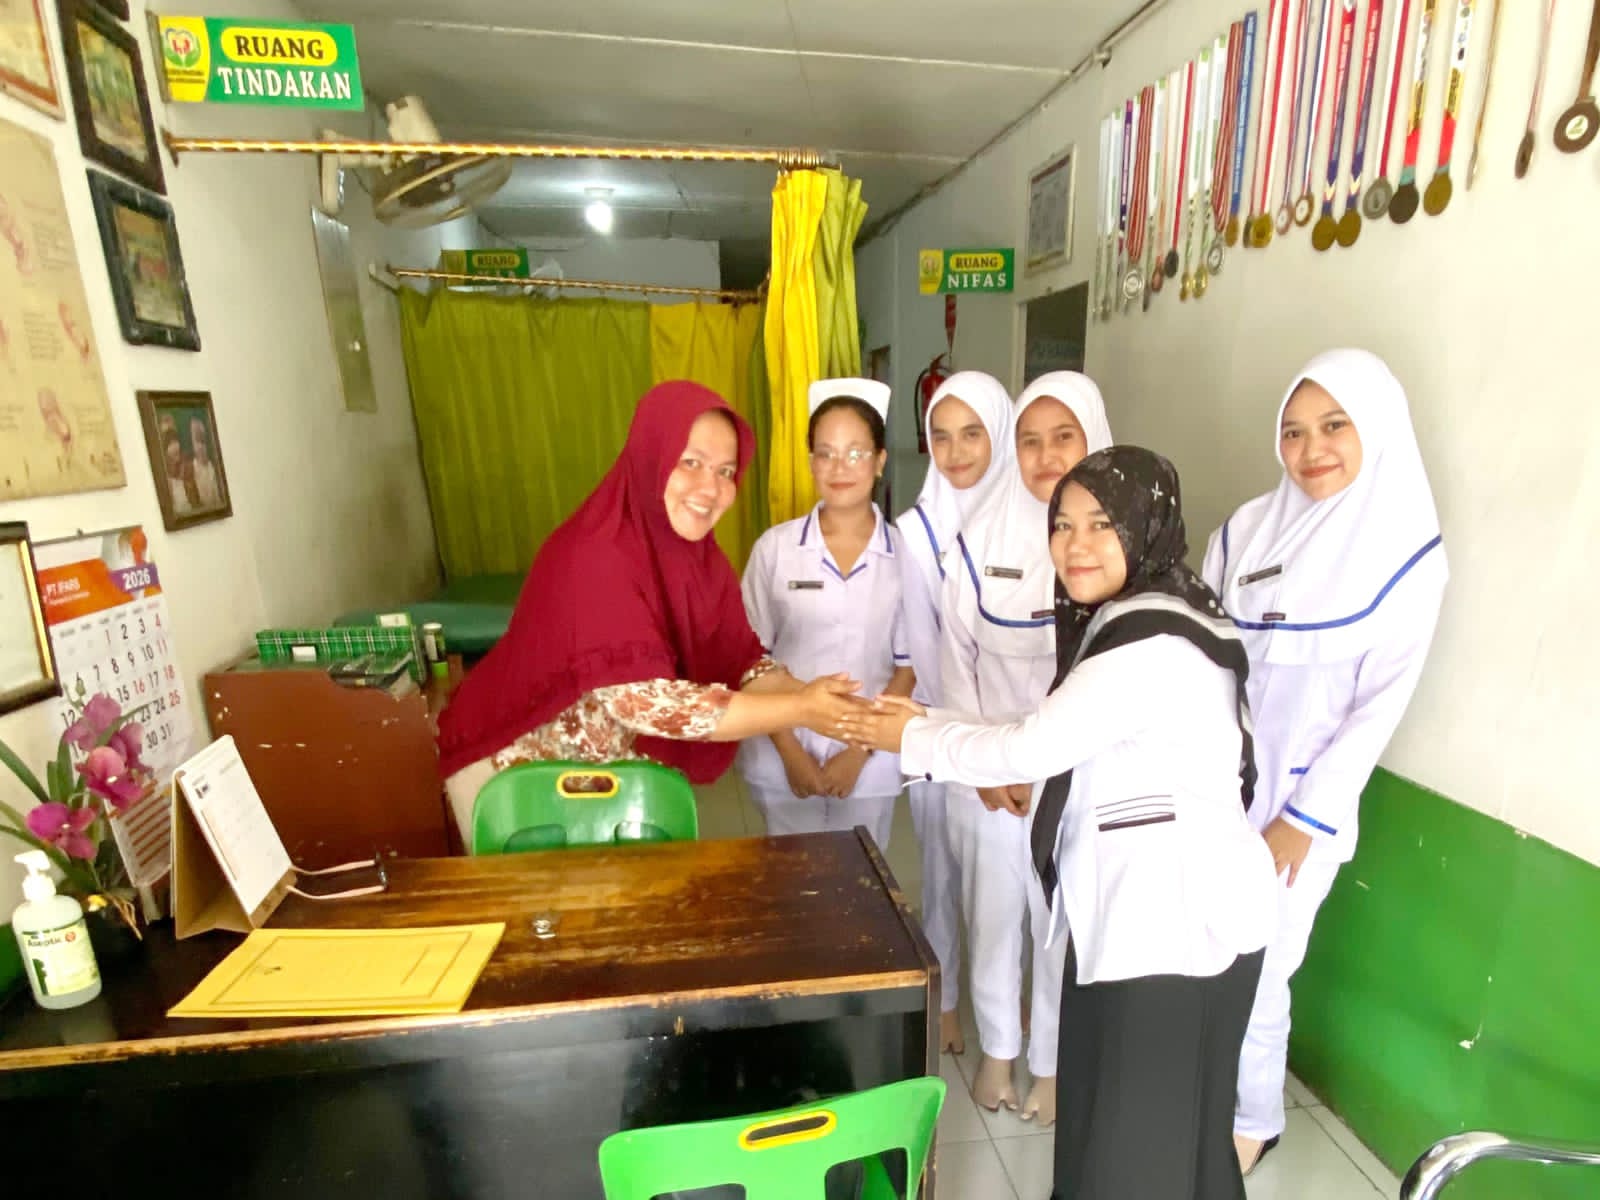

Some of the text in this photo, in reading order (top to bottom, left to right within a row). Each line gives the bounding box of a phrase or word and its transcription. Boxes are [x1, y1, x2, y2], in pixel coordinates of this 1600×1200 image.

[234, 35, 324, 60] RUANG
[217, 67, 352, 100] TINDAKAN
[955, 256, 999, 269] RUANG
[947, 272, 1007, 289] NIFAS
[122, 568, 151, 590] 2026
[105, 629, 111, 646] 1
[121, 623, 128, 640] 2
[139, 617, 145, 634] 3
[155, 612, 161, 628] 4
[93, 636, 168, 681] 7 8 9 10 11
[117, 684, 129, 703] 15
[133, 678, 145, 695] 16
[149, 670, 159, 689] 17
[164, 664, 175, 681] 18
[168, 689, 181, 707] 25
[146, 723, 171, 749] 30 31
